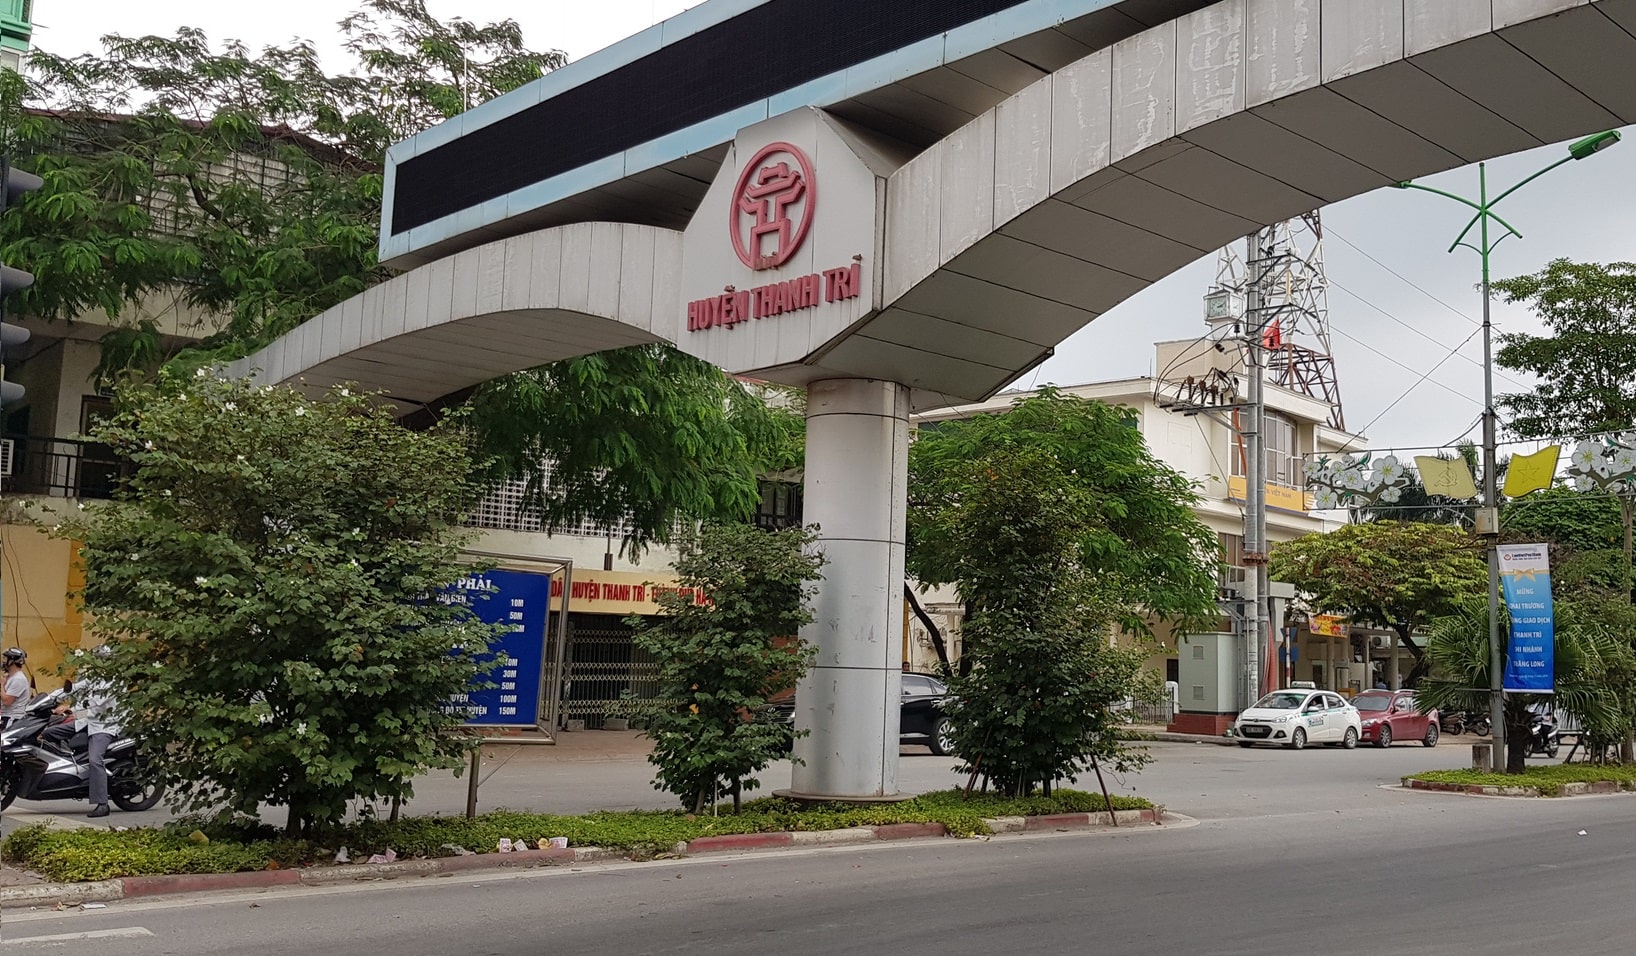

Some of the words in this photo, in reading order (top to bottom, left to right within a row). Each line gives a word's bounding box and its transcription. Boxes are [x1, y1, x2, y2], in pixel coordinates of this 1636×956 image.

[687, 284, 749, 332] HUYỆN
[750, 273, 820, 320] THANH
[457, 574, 491, 590] PHẢI
[571, 578, 601, 603] HUYỆN
[602, 583, 631, 601] THANH
[511, 599, 524, 607] 10M
[509, 611, 523, 620] 50M
[502, 669, 517, 678] 30M
[501, 682, 516, 690] 50M
[500, 695, 517, 703] 100M
[499, 706, 517, 715] 150M
